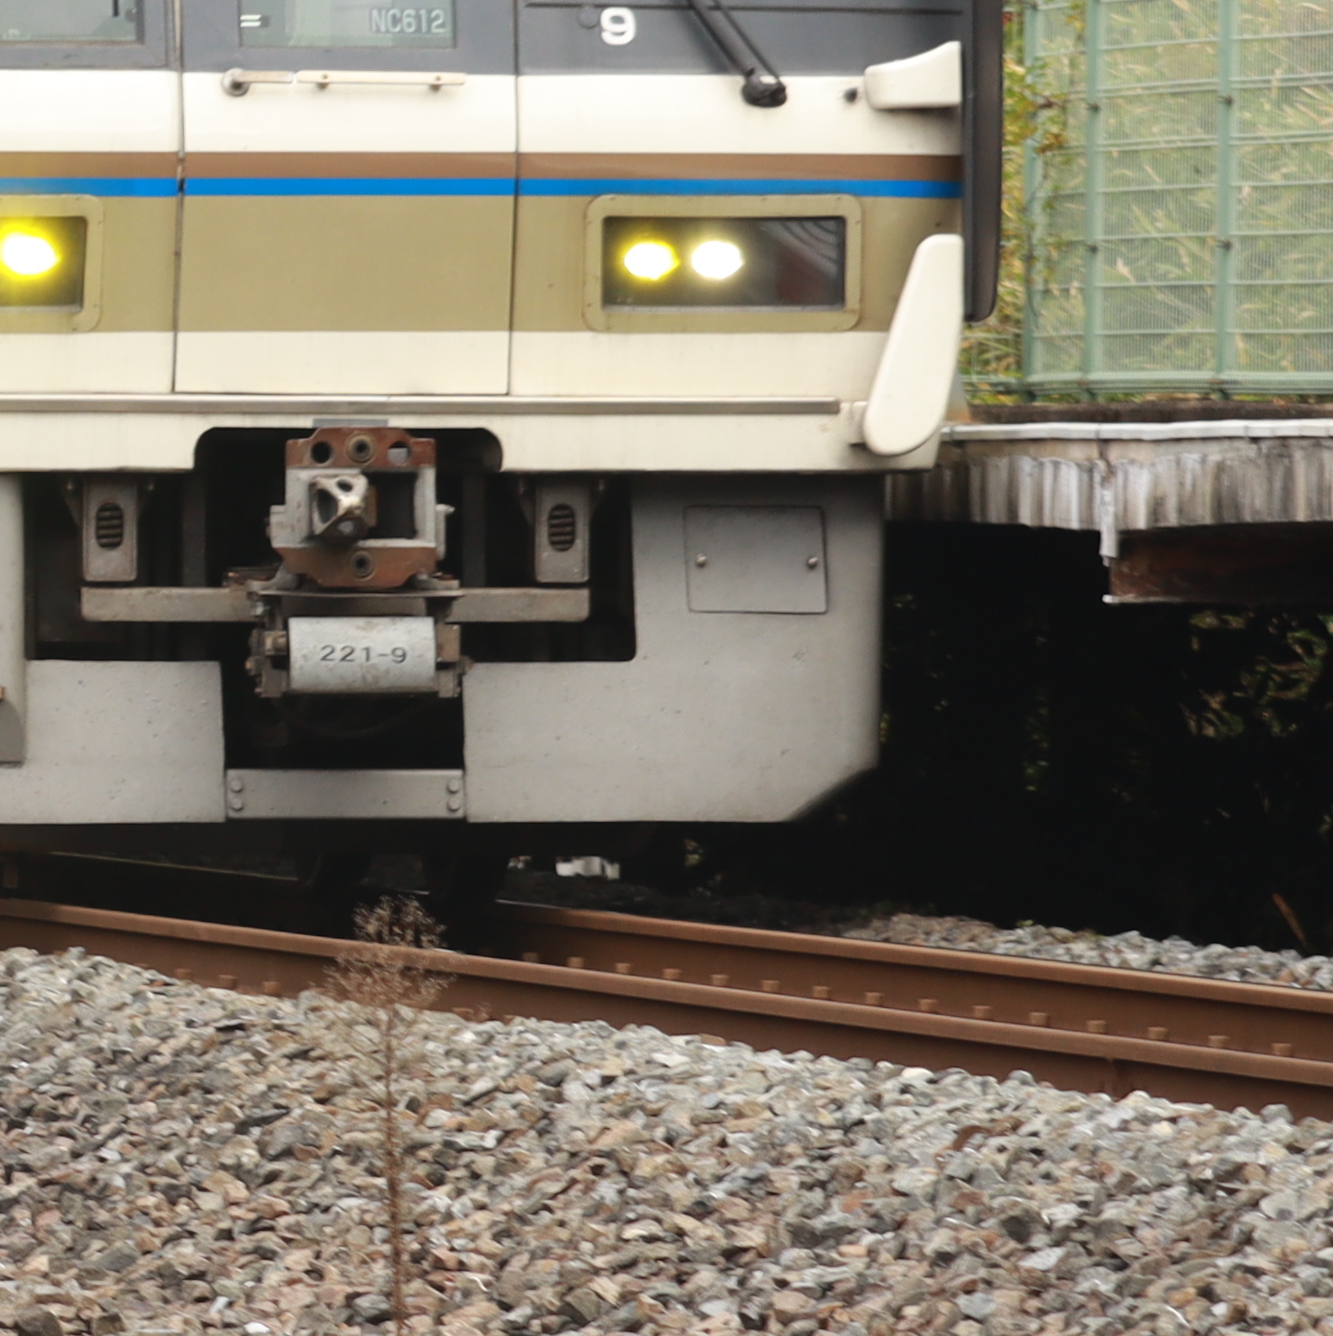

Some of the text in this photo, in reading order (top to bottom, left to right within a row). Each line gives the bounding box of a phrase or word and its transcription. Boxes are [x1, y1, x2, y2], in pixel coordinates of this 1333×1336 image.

[371, 8, 447, 34] NC612
[600, 7, 636, 45] 9
[320, 644, 407, 664] 221-9
